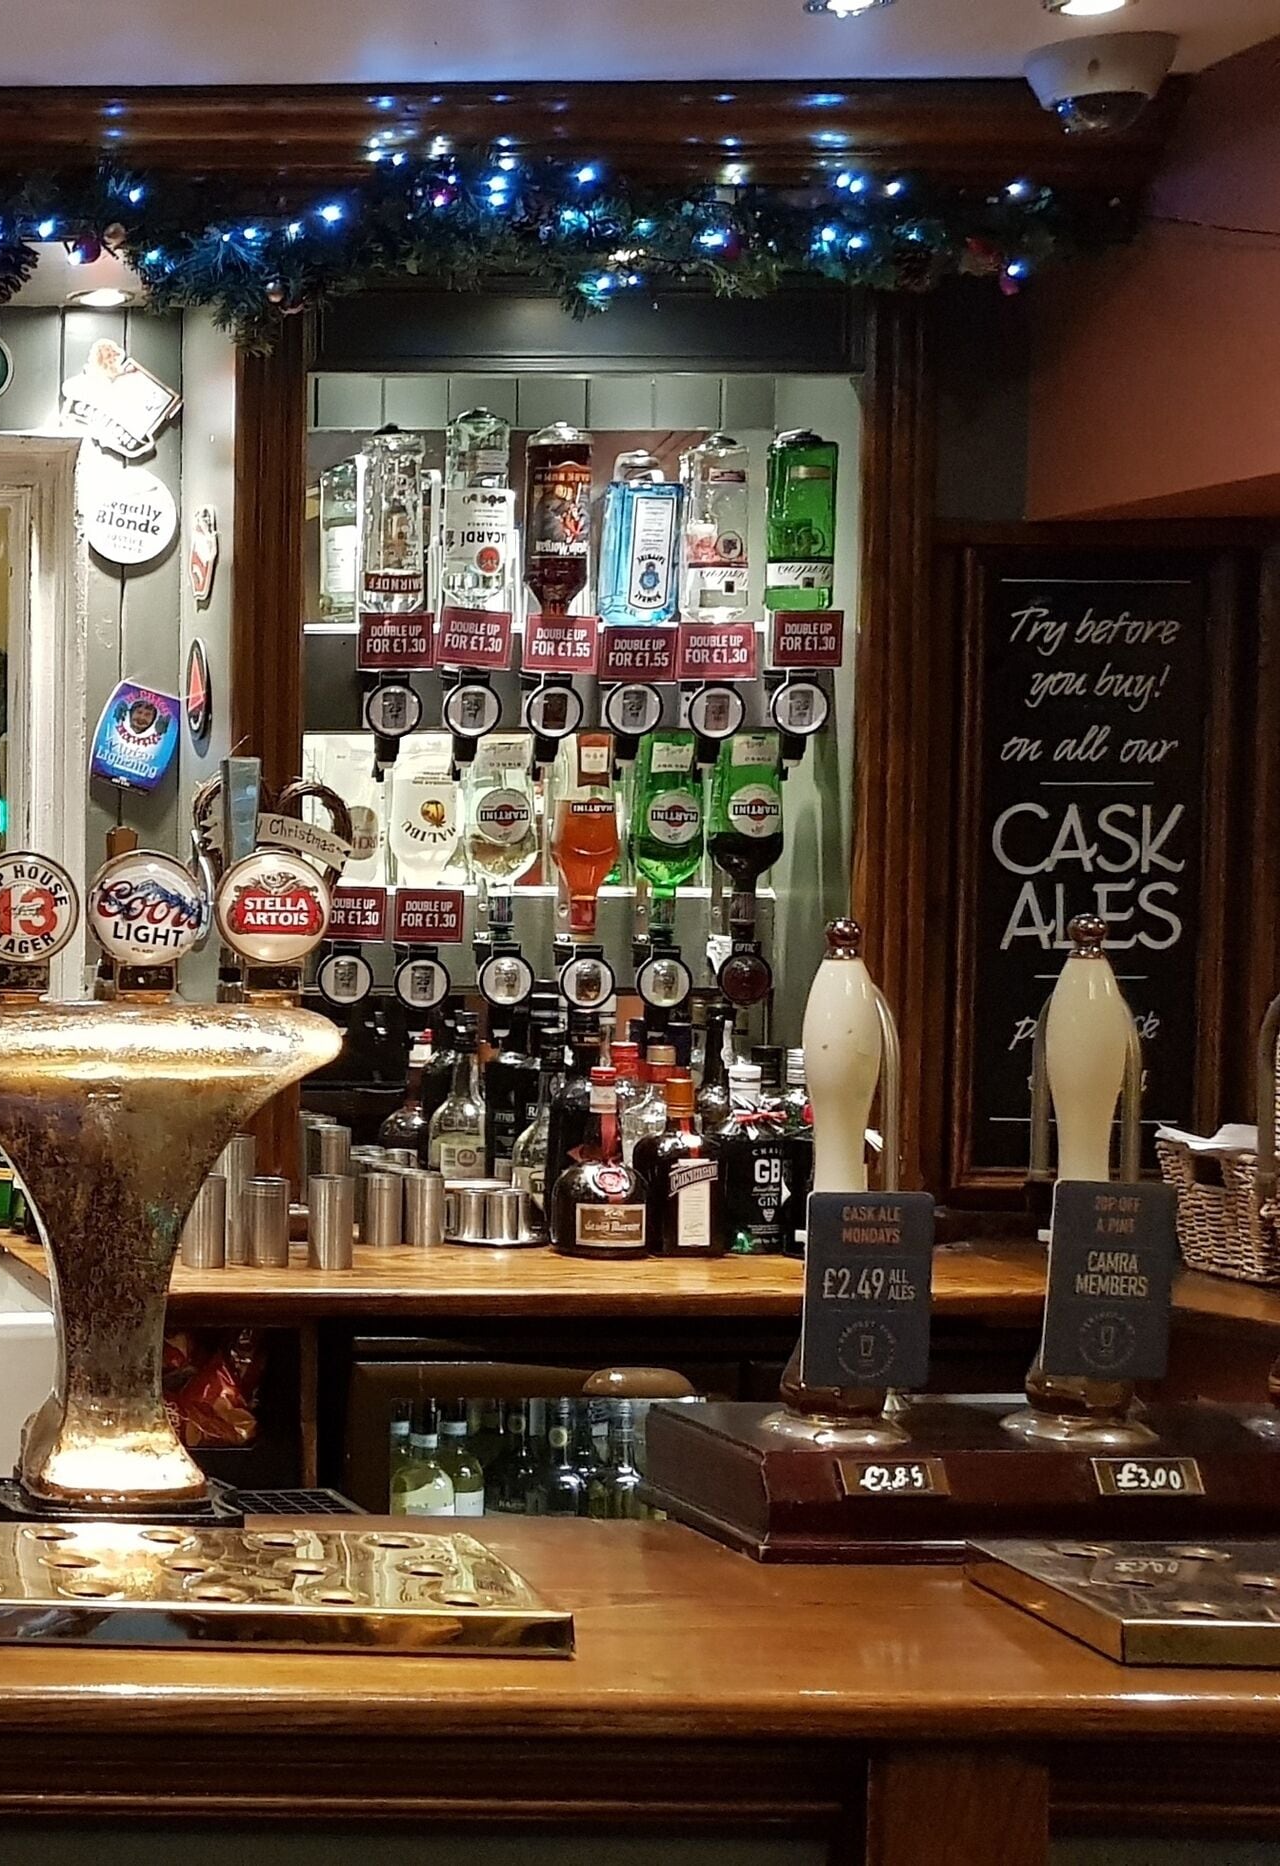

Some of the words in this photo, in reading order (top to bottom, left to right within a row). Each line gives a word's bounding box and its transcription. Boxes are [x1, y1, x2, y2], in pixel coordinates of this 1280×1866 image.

[96, 509, 160, 535] Blonde
[370, 625, 407, 637] DOUBLE
[408, 624, 422, 637] UP
[450, 621, 485, 636] DOUBLE
[487, 623, 500, 637] UP
[536, 627, 573, 640] DOUBLE
[574, 628, 588, 641] UP
[784, 623, 817, 635] DOUBLE
[819, 623, 833, 635] UP
[1010, 603, 1068, 656] Try
[1075, 608, 1181, 646] before
[366, 639, 390, 653] FOR
[393, 638, 426, 653] £1.30
[444, 634, 467, 650] FOR
[470, 636, 503, 652] £1.30
[531, 641, 555, 656] FOR
[557, 642, 590, 657] £1.55
[614, 638, 650, 651] DOUBLE
[651, 638, 666, 651] UP
[690, 635, 727, 648] DOUBLE
[729, 635, 744, 648] UP
[780, 637, 802, 651] FOR
[804, 635, 836, 651] £1.30
[608, 652, 632, 667] FOR
[635, 652, 669, 667] £1.55
[685, 648, 710, 663] FOR
[713, 647, 748, 663] £1.30
[1024, 668, 1088, 709] you
[1093, 664, 1170, 713] buy!
[1000, 735, 1043, 763] on
[1052, 725, 1111, 764] all
[1119, 737, 1179, 764] our
[479, 809, 529, 821] MARTINI
[571, 802, 615, 813] MARTINI
[651, 809, 698, 822] MARTINI
[734, 804, 779, 816] MARTINI
[269, 818, 342, 854] Christmas
[401, 819, 457, 845] MALIBU
[991, 801, 1186, 875] CASK
[13, 864, 68, 907] HOUSE
[97, 879, 203, 932] Coors
[243, 897, 308, 911] STELLA
[362, 898, 376, 910] UP
[405, 900, 439, 912] DOUBLE
[440, 901, 453, 913] UP
[243, 911, 309, 926] ARTOIS
[347, 911, 379, 925] £1.30
[401, 913, 424, 927] FOR
[426, 913, 456, 928] £1.30
[999, 878, 1184, 951] ALES
[113, 921, 184, 947] LIGHT
[754, 1159, 781, 1184] GB
[758, 1196, 779, 1207] GIN
[842, 1206, 877, 1223] CASK
[879, 1206, 901, 1222] ALE
[842, 1227, 901, 1245] MONDAYS
[1087, 1251, 1139, 1275] CAMRA
[822, 1267, 885, 1300] £2.49
[888, 1269, 908, 1285] ALL
[1075, 1273, 1147, 1298] MEMBERS
[888, 1285, 916, 1301] ALES
[1116, 1463, 1182, 1490] £3.00
